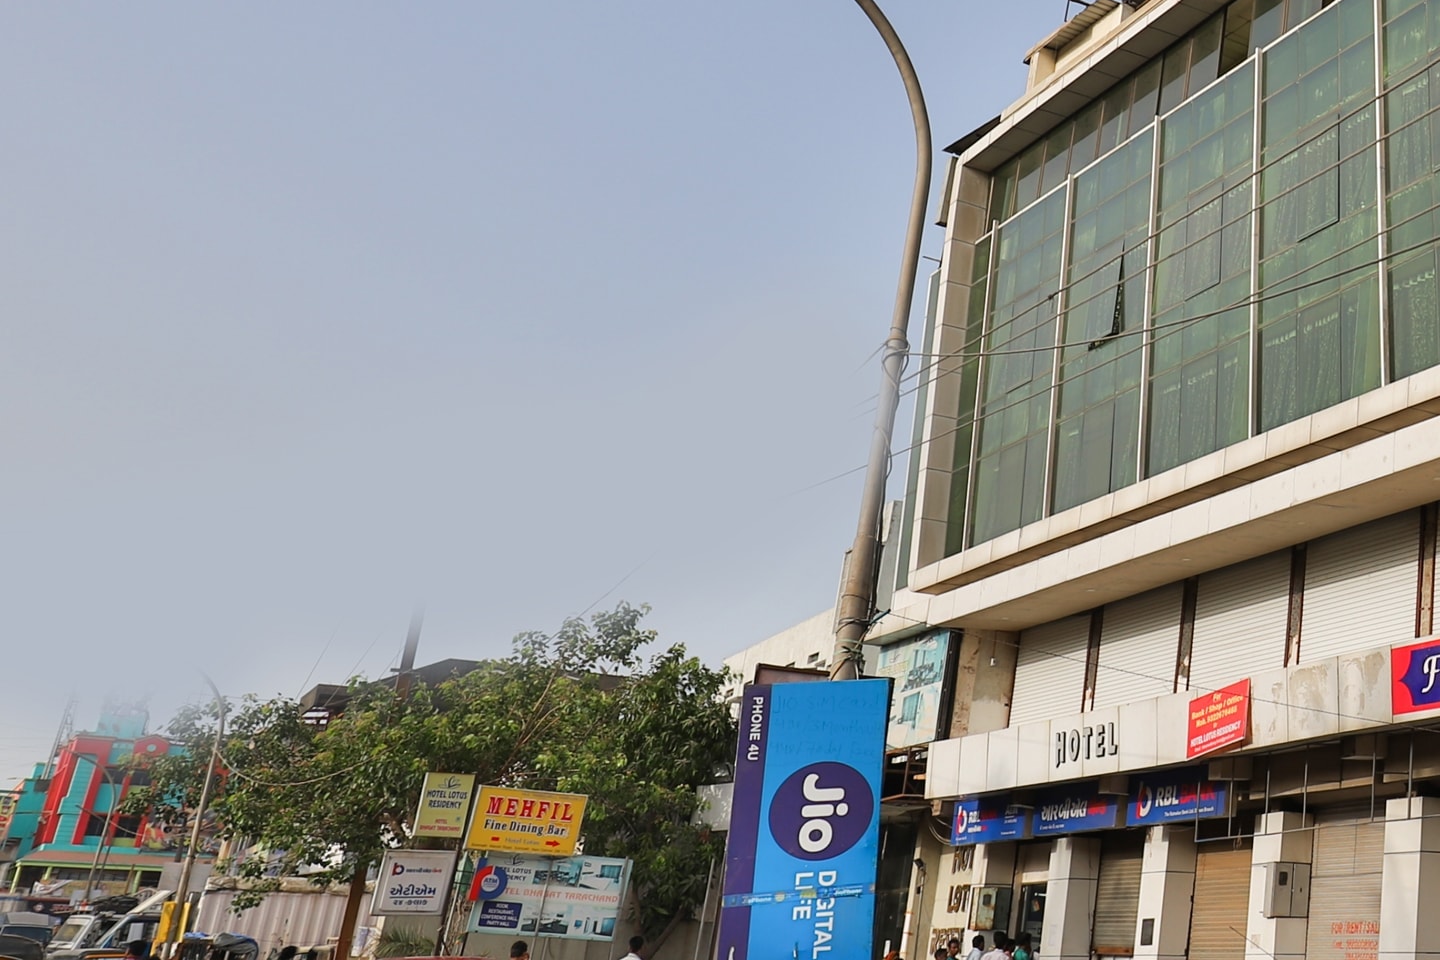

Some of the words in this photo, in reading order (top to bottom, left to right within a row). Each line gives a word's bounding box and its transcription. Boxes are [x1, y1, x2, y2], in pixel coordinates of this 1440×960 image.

[749, 696, 765, 741] PHONE
[747, 743, 761, 761] 4U
[1055, 722, 1118, 768] HOTEL
[427, 790, 447, 799] HOTEL
[448, 791, 468, 800] LOTUS
[428, 800, 462, 809] RESIDENCY
[1155, 784, 1179, 808] RBL
[486, 796, 574, 822] MEHFIL
[799, 773, 849, 853] Jio
[484, 819, 507, 831] Fine
[509, 821, 544, 837] Dining
[389, 884, 436, 896] એટીએમ
[505, 887, 520, 896] TEL
[792, 872, 815, 921] LIE
[812, 870, 837, 960] DGITAL
